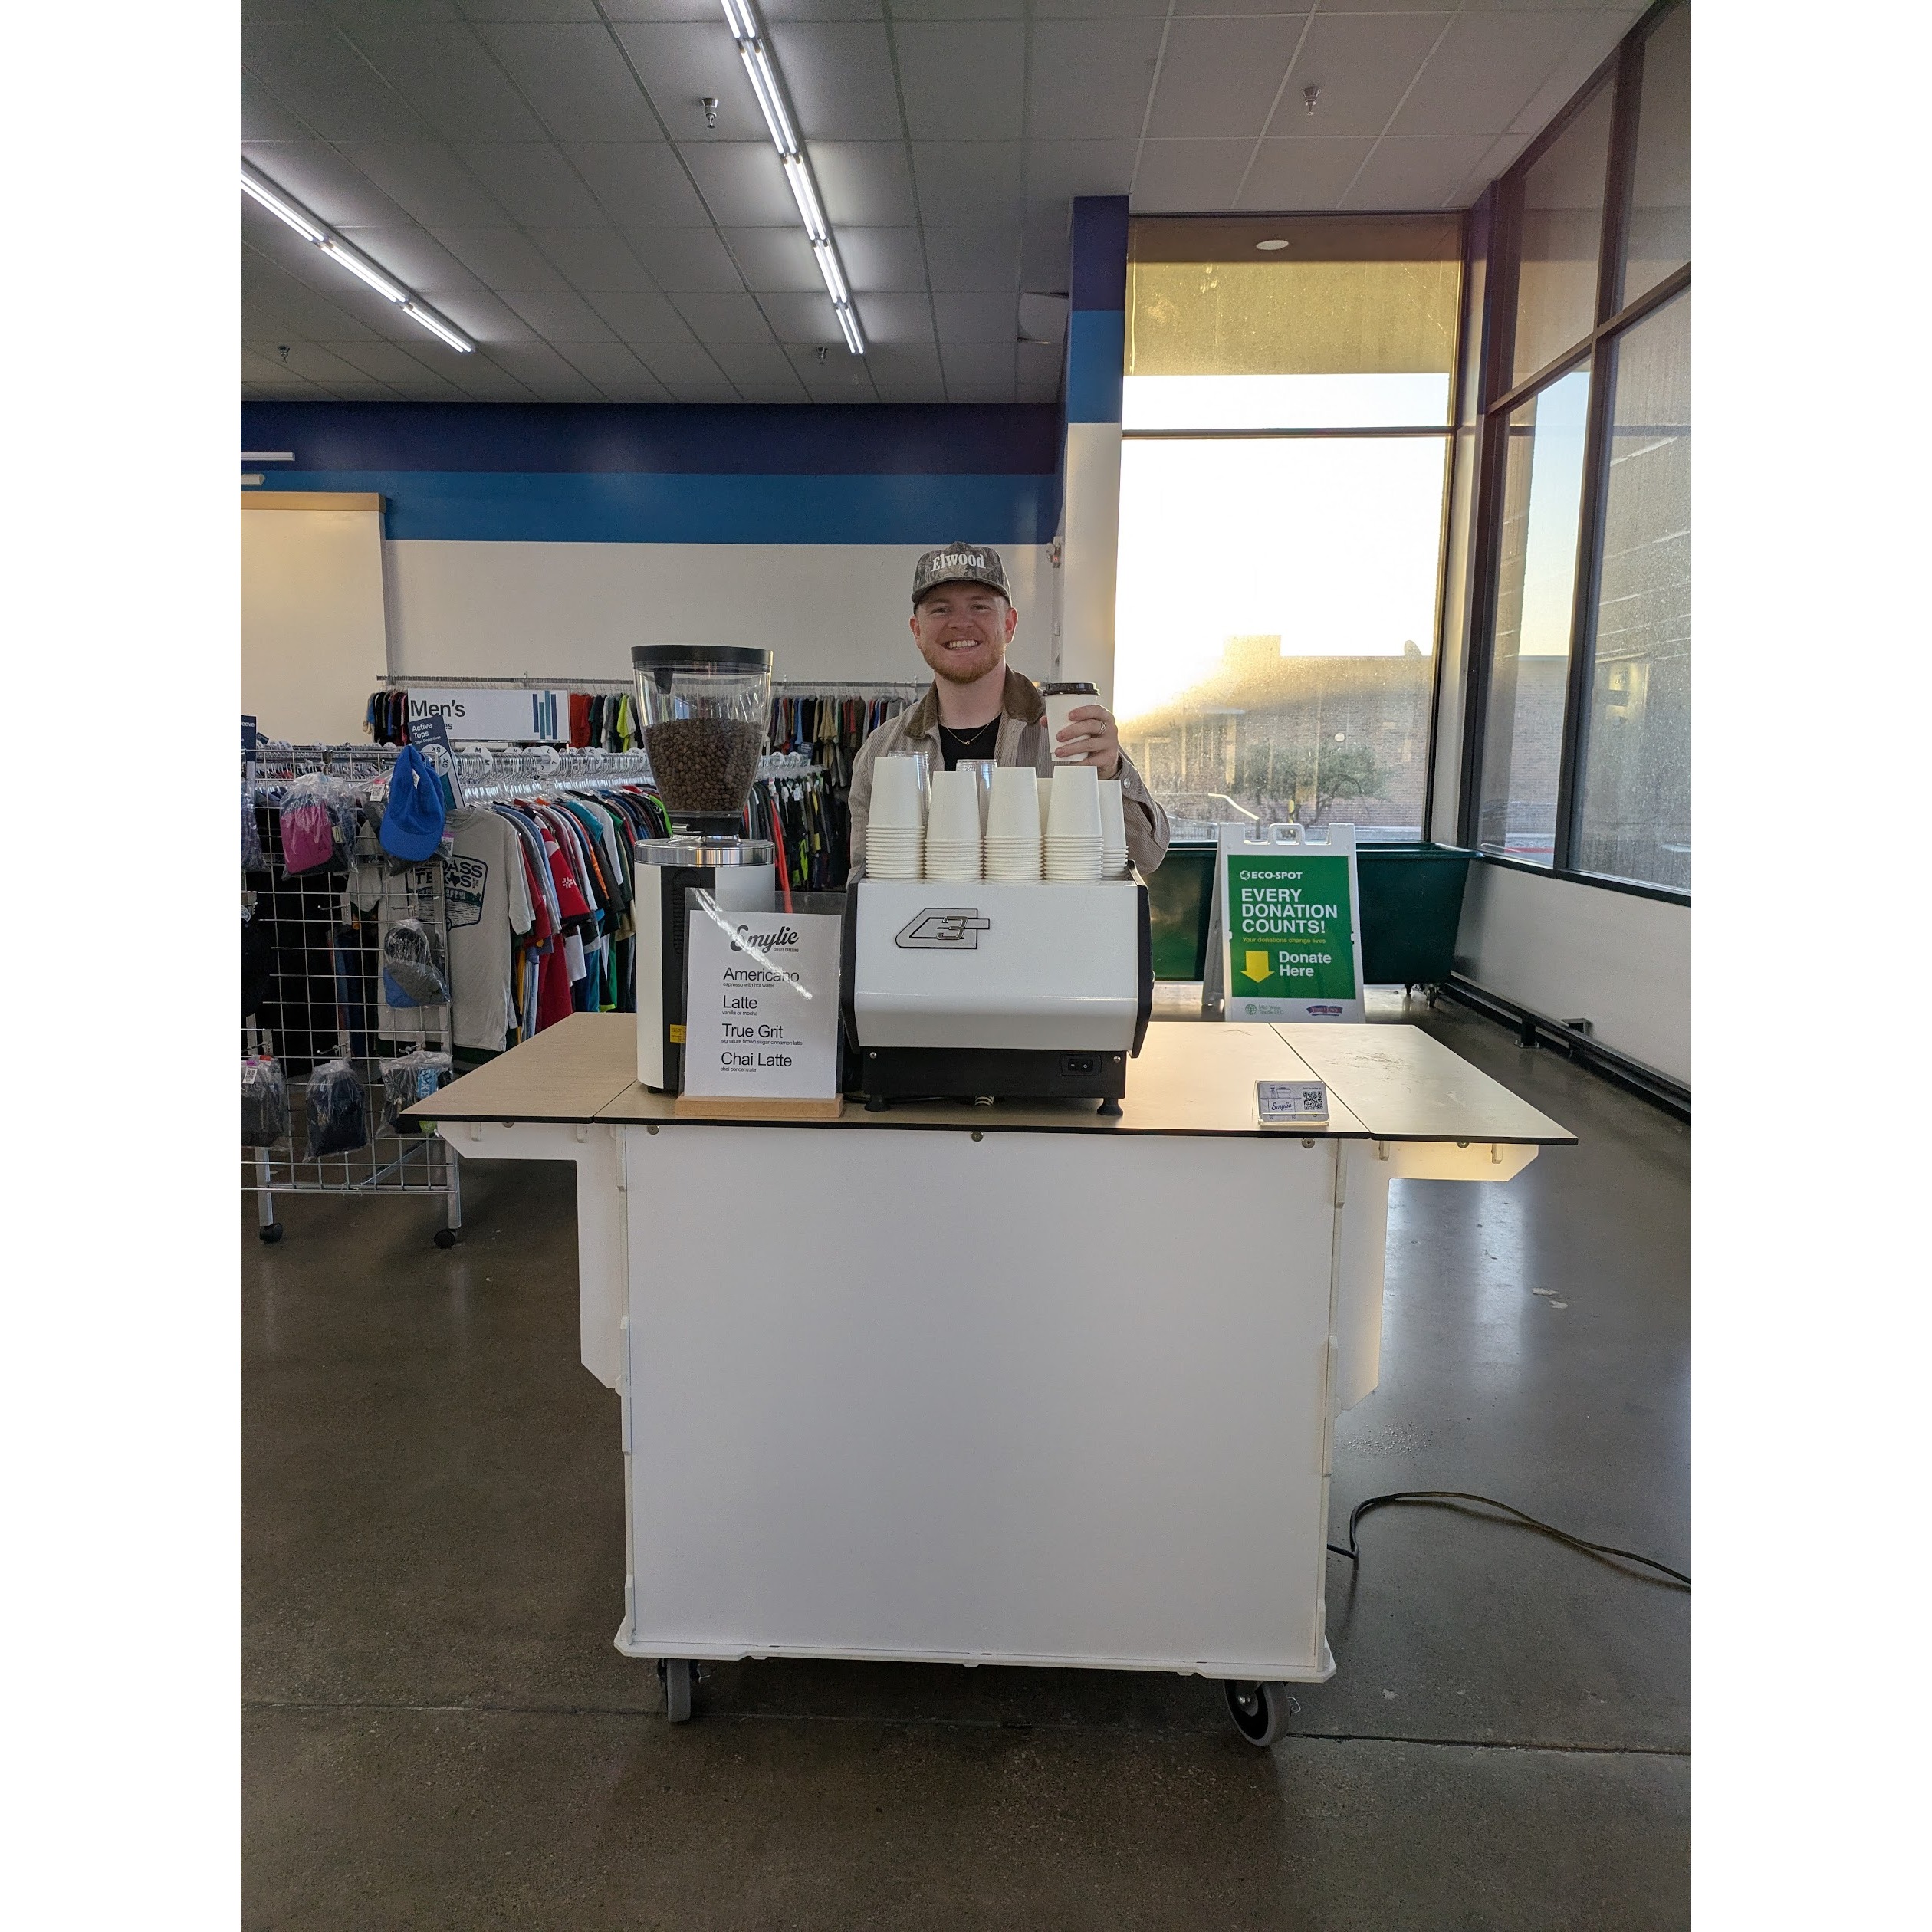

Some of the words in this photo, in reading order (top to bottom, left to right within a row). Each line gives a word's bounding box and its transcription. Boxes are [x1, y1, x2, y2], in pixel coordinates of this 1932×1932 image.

[932, 553, 987, 572] Elwood
[410, 699, 465, 718] Men's
[412, 723, 432, 732] Active
[442, 758, 449, 768] XS
[1251, 871, 1303, 879] ECO-SPOT
[1241, 888, 1303, 902] EVERY
[1242, 903, 1338, 918] DONATION
[1242, 919, 1326, 934] COUNTS!
[730, 925, 800, 954] Smylie
[1279, 951, 1332, 964] Donate
[723, 967, 800, 982] Americano
[1280, 964, 1314, 977] Here
[723, 995, 757, 1009] Latte
[722, 1023, 754, 1037] True
[758, 1024, 783, 1038] Grit
[721, 1051, 754, 1066] Chai
[758, 1053, 792, 1067] Latte
[1271, 1102, 1293, 1111] Smylie
